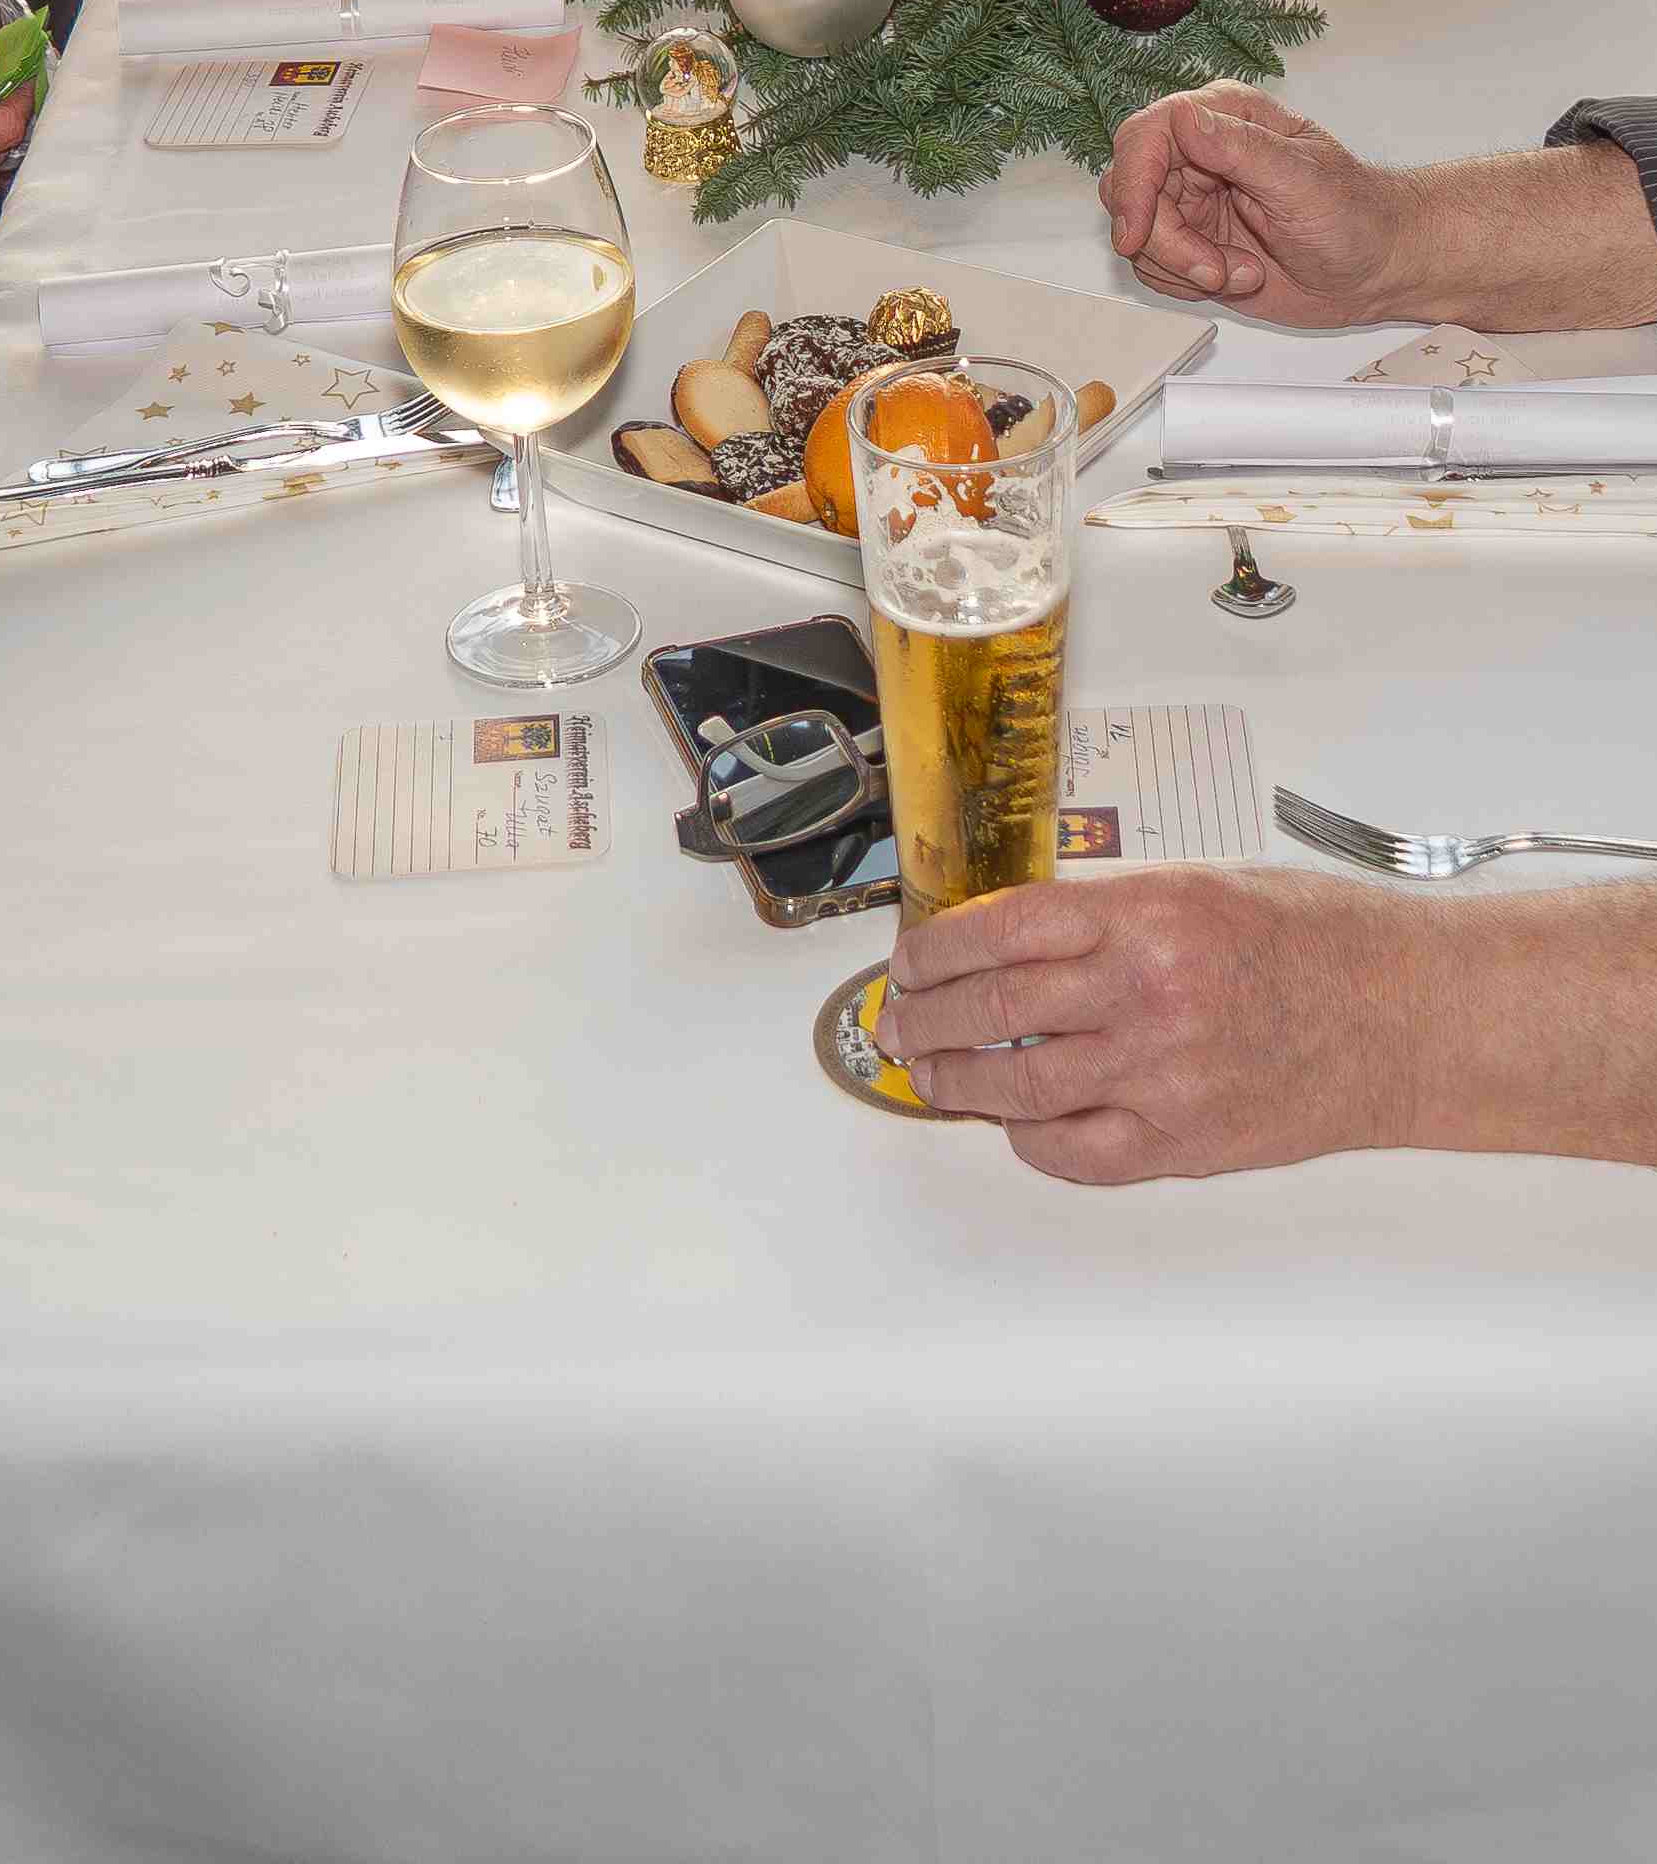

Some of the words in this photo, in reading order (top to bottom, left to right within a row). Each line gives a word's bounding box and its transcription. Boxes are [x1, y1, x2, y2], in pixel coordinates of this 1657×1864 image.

[564, 714, 594, 789] Heimatverein
[476, 825, 499, 849] 70
[566, 790, 598, 851] Ascheberg
